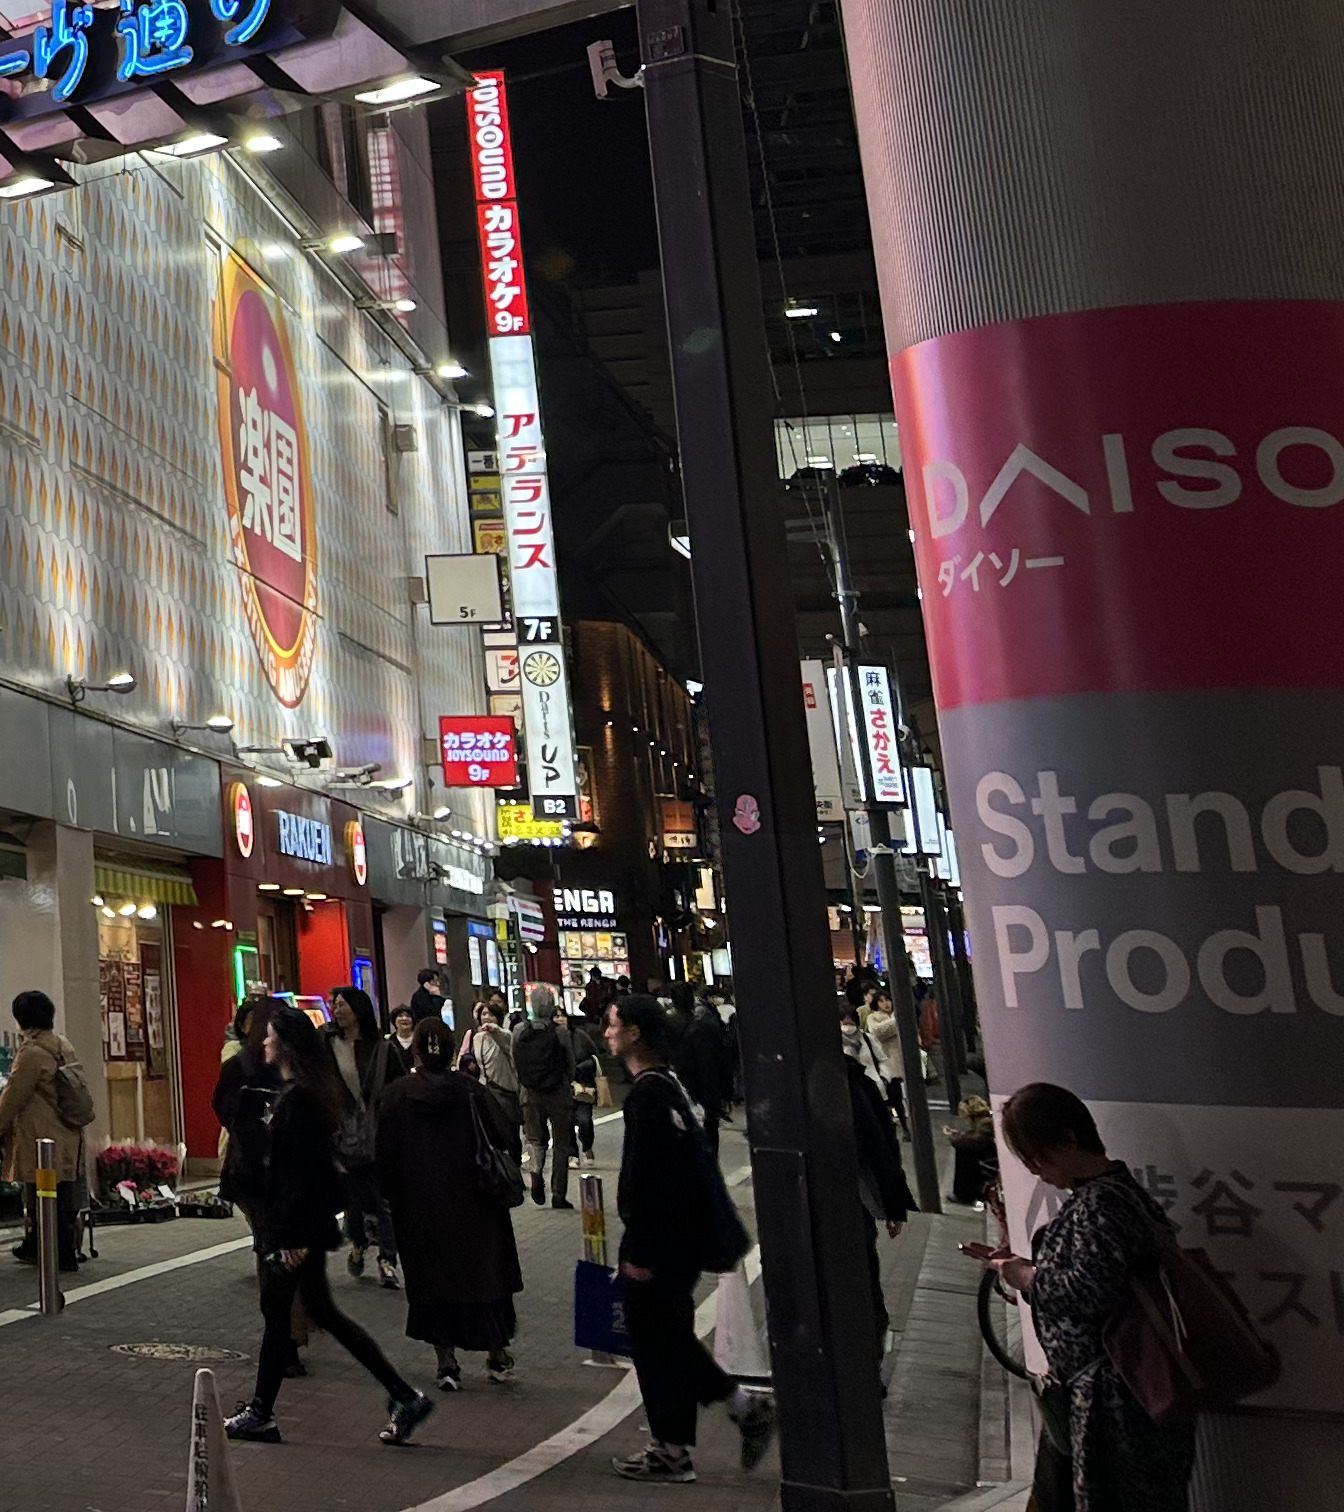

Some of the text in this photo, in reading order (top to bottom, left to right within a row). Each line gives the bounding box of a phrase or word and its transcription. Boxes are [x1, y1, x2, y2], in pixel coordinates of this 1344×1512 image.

[473, 75, 508, 199] JOYSOUND
[484, 204, 520, 310] カラオケ
[494, 310, 524, 333] 9F
[239, 386, 302, 563] 楽園
[503, 413, 551, 570] アデランス
[937, 548, 1065, 597] ダイソー
[459, 606, 477, 619] 5F
[523, 619, 552, 641] 7F
[444, 732, 511, 749] カラオケ
[447, 749, 509, 762] JOYSOUND
[468, 764, 490, 781] 9F
[543, 799, 566, 815] B2
[276, 810, 332, 866] RAKUEN
